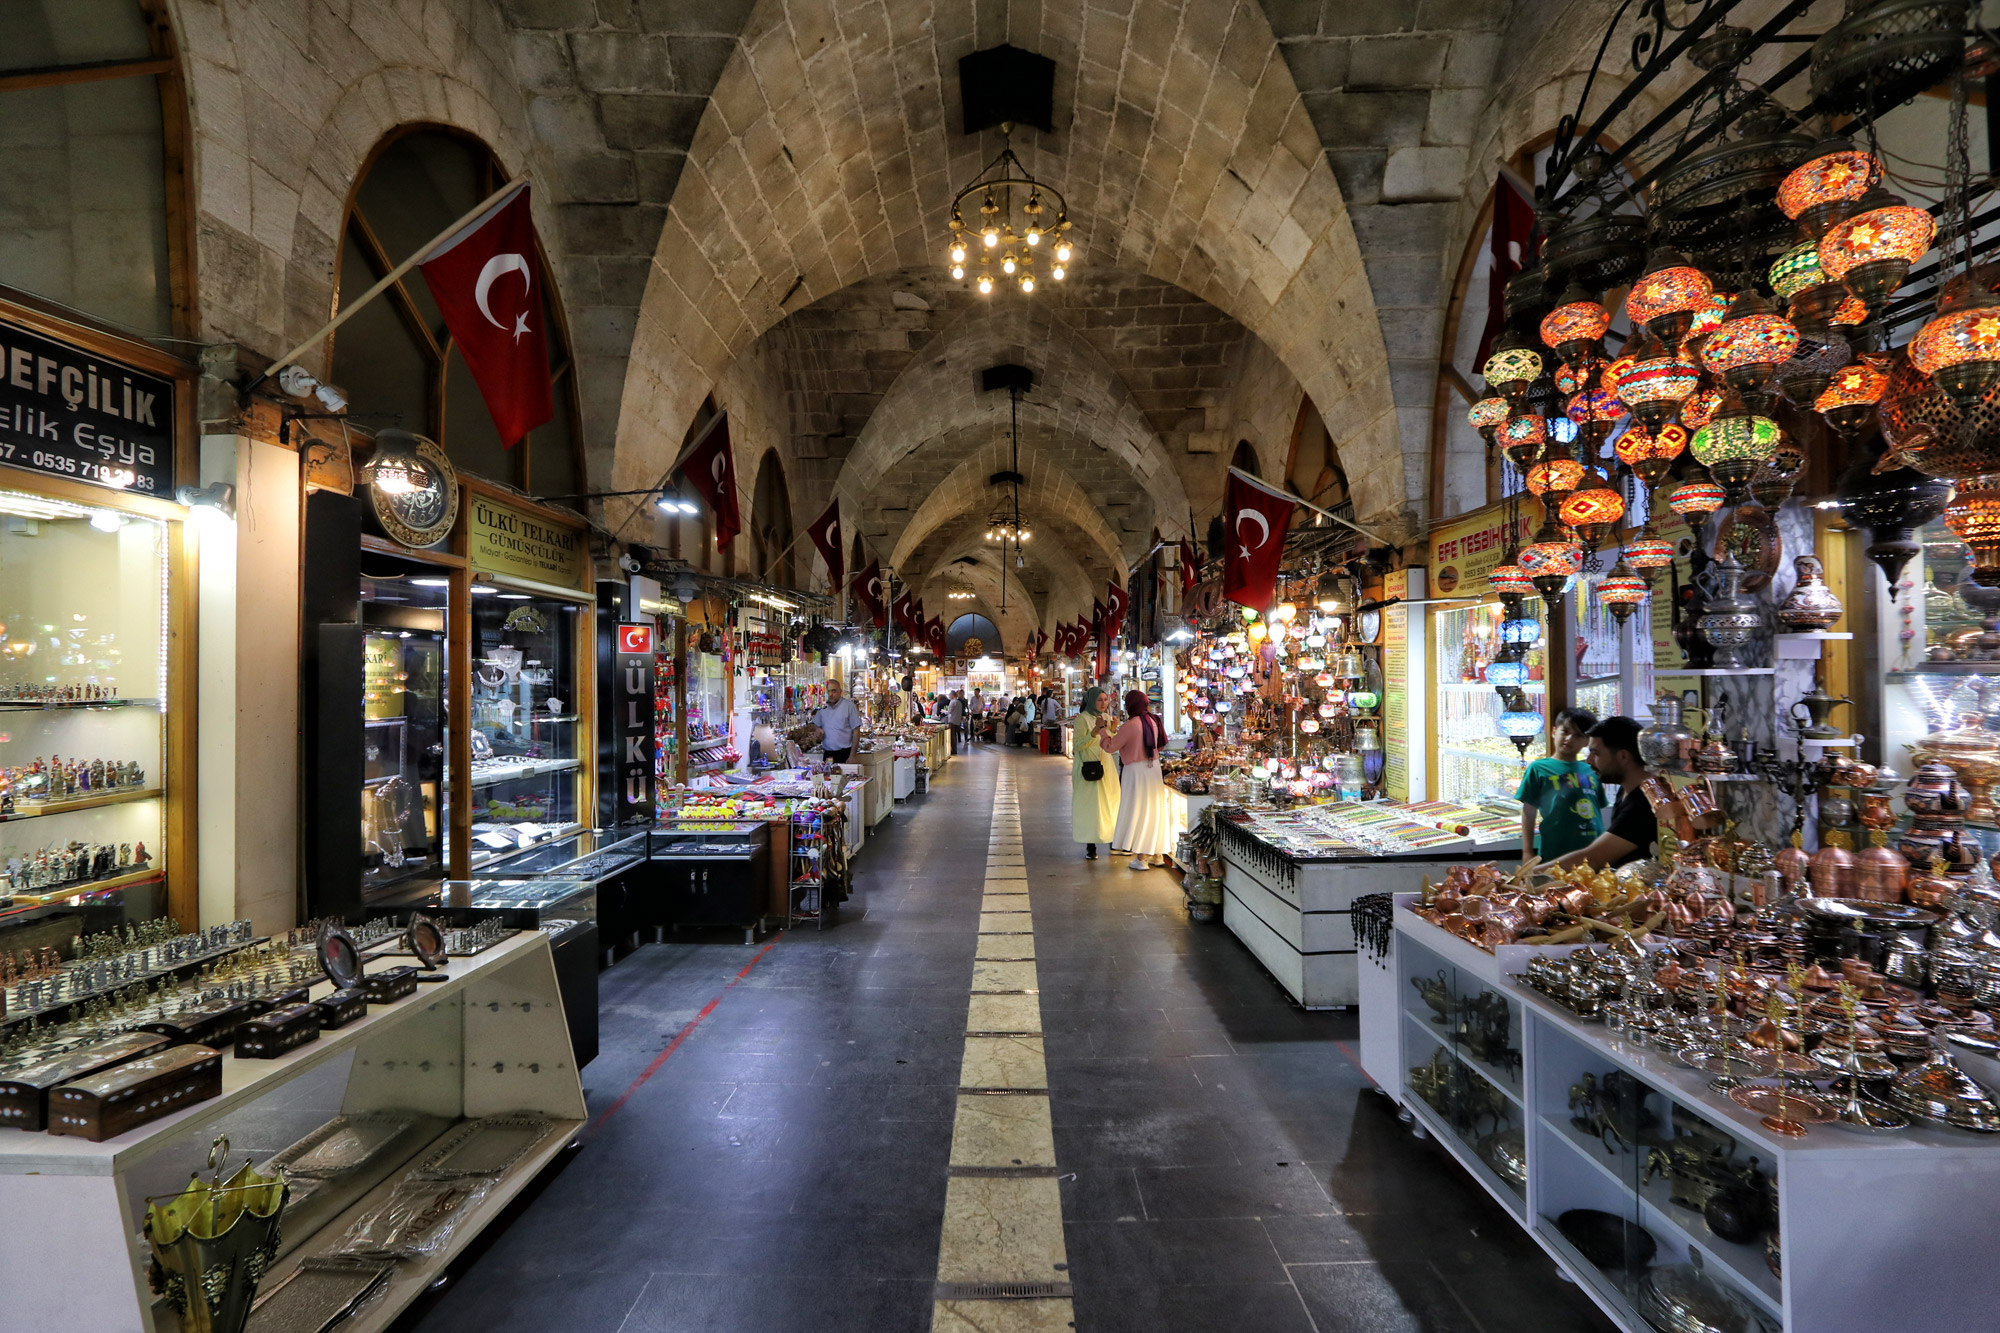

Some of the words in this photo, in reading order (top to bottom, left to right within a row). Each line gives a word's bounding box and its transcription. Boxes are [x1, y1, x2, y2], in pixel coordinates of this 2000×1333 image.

[0, 343, 156, 427] EFÇİLİK
[73, 422, 155, 466] Eşya
[33, 450, 76, 473] 0535
[137, 474, 155, 490] 83
[476, 503, 518, 534] ÜLKÜ
[521, 521, 574, 552] TELKARİ
[489, 532, 565, 564] GÜMÜŞÇÜLÜK
[1438, 540, 1459, 564] EFE
[1460, 512, 1533, 557] TESBİHCİK
[479, 545, 501, 557] Midyat
[625, 659, 648, 805] ÜLKÜ
